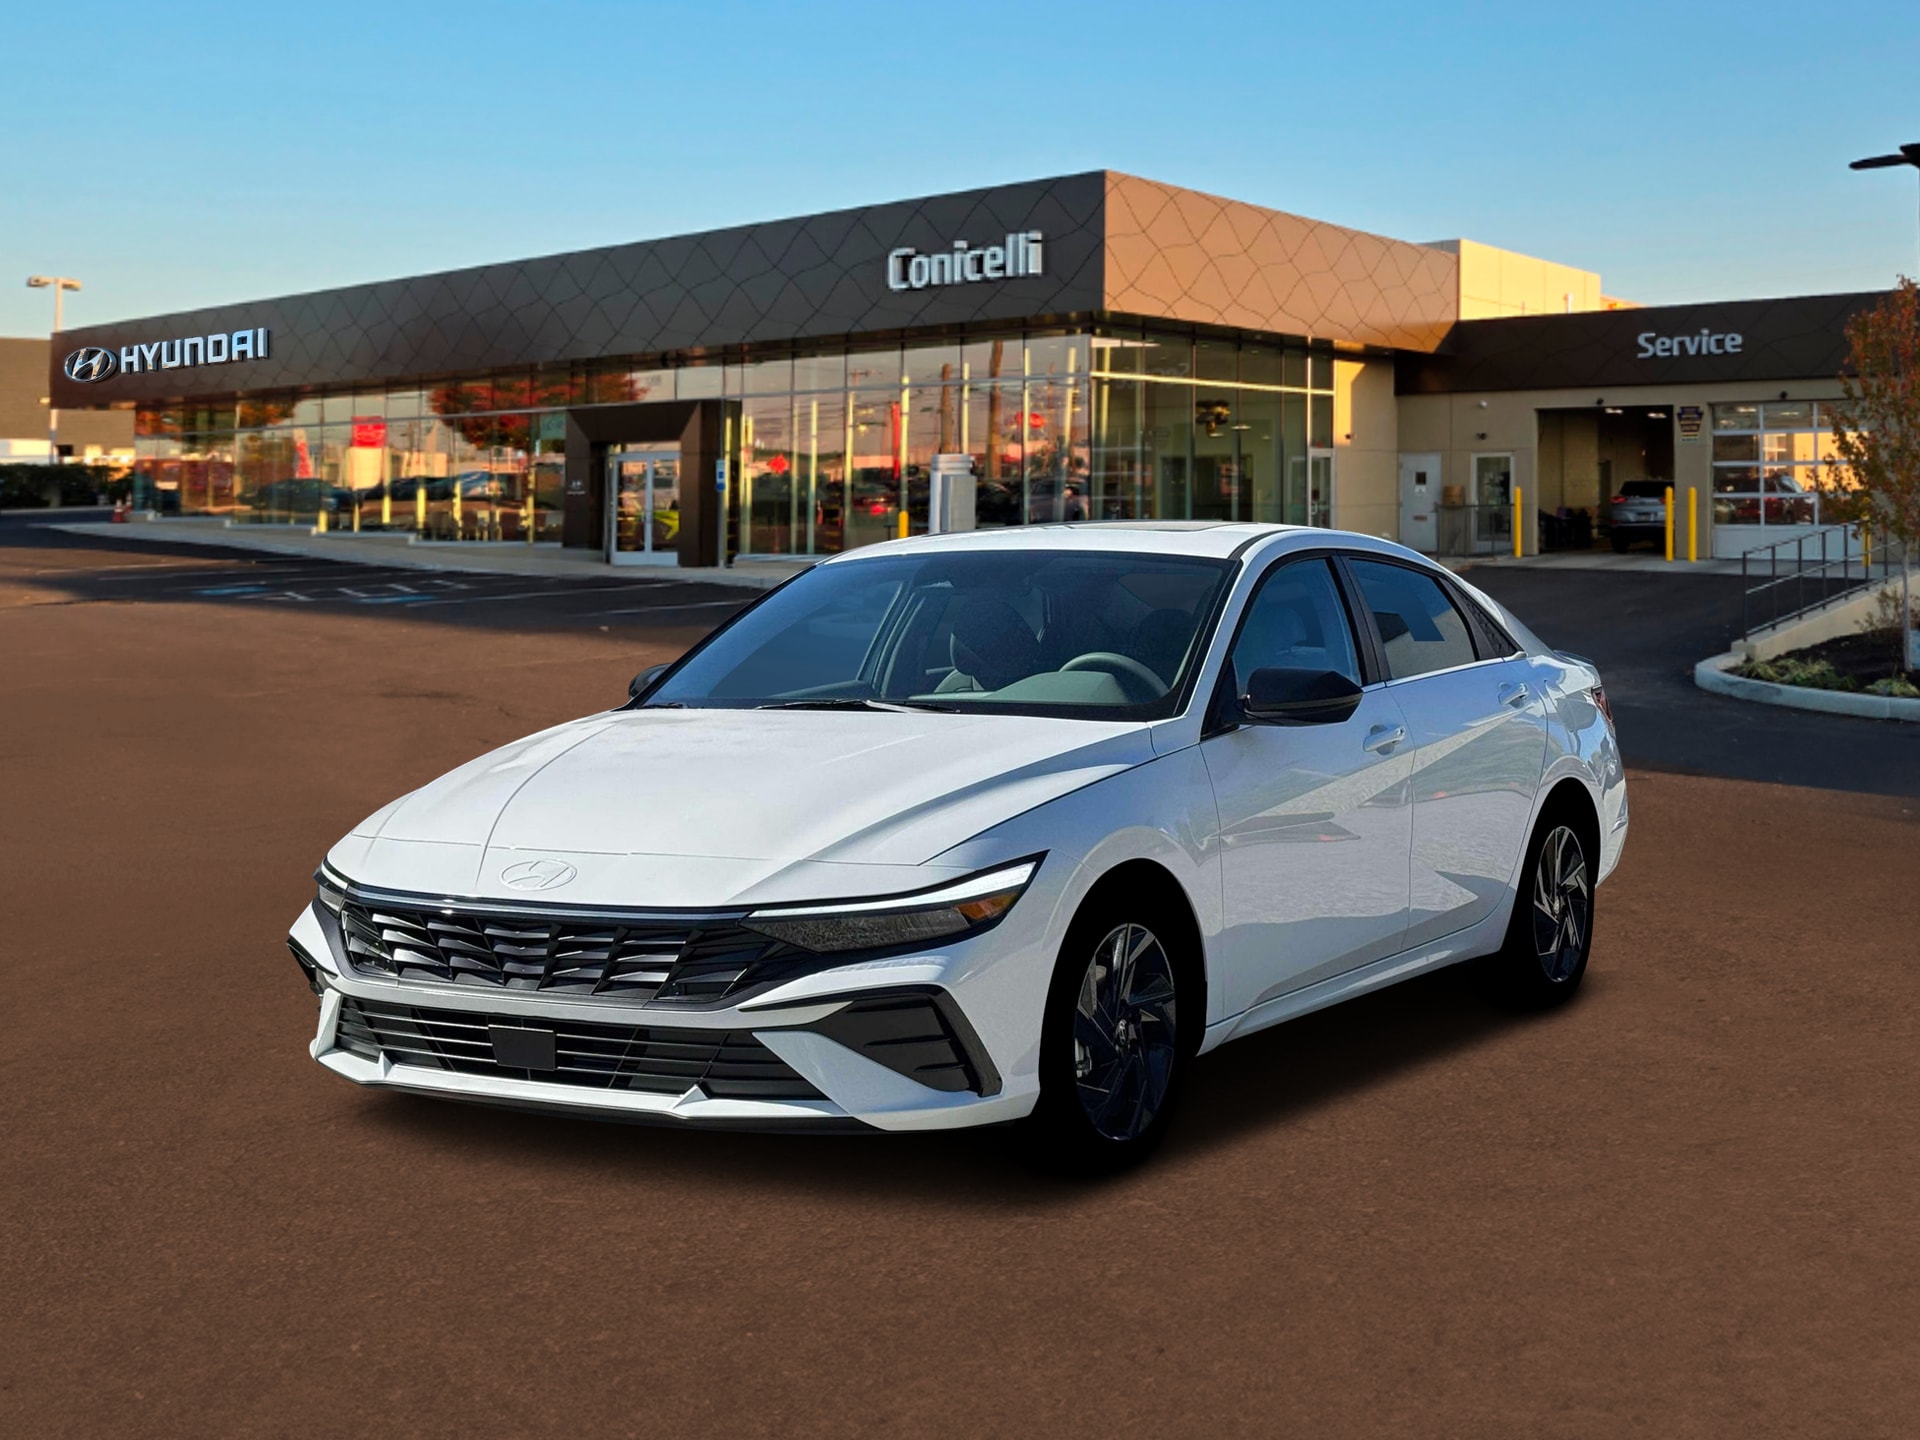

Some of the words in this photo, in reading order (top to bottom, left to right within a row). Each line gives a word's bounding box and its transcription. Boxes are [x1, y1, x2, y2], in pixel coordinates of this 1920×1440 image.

[887, 230, 1043, 290] Conicelli
[120, 327, 268, 374] HYUNDAI
[1637, 327, 1743, 359] Service
